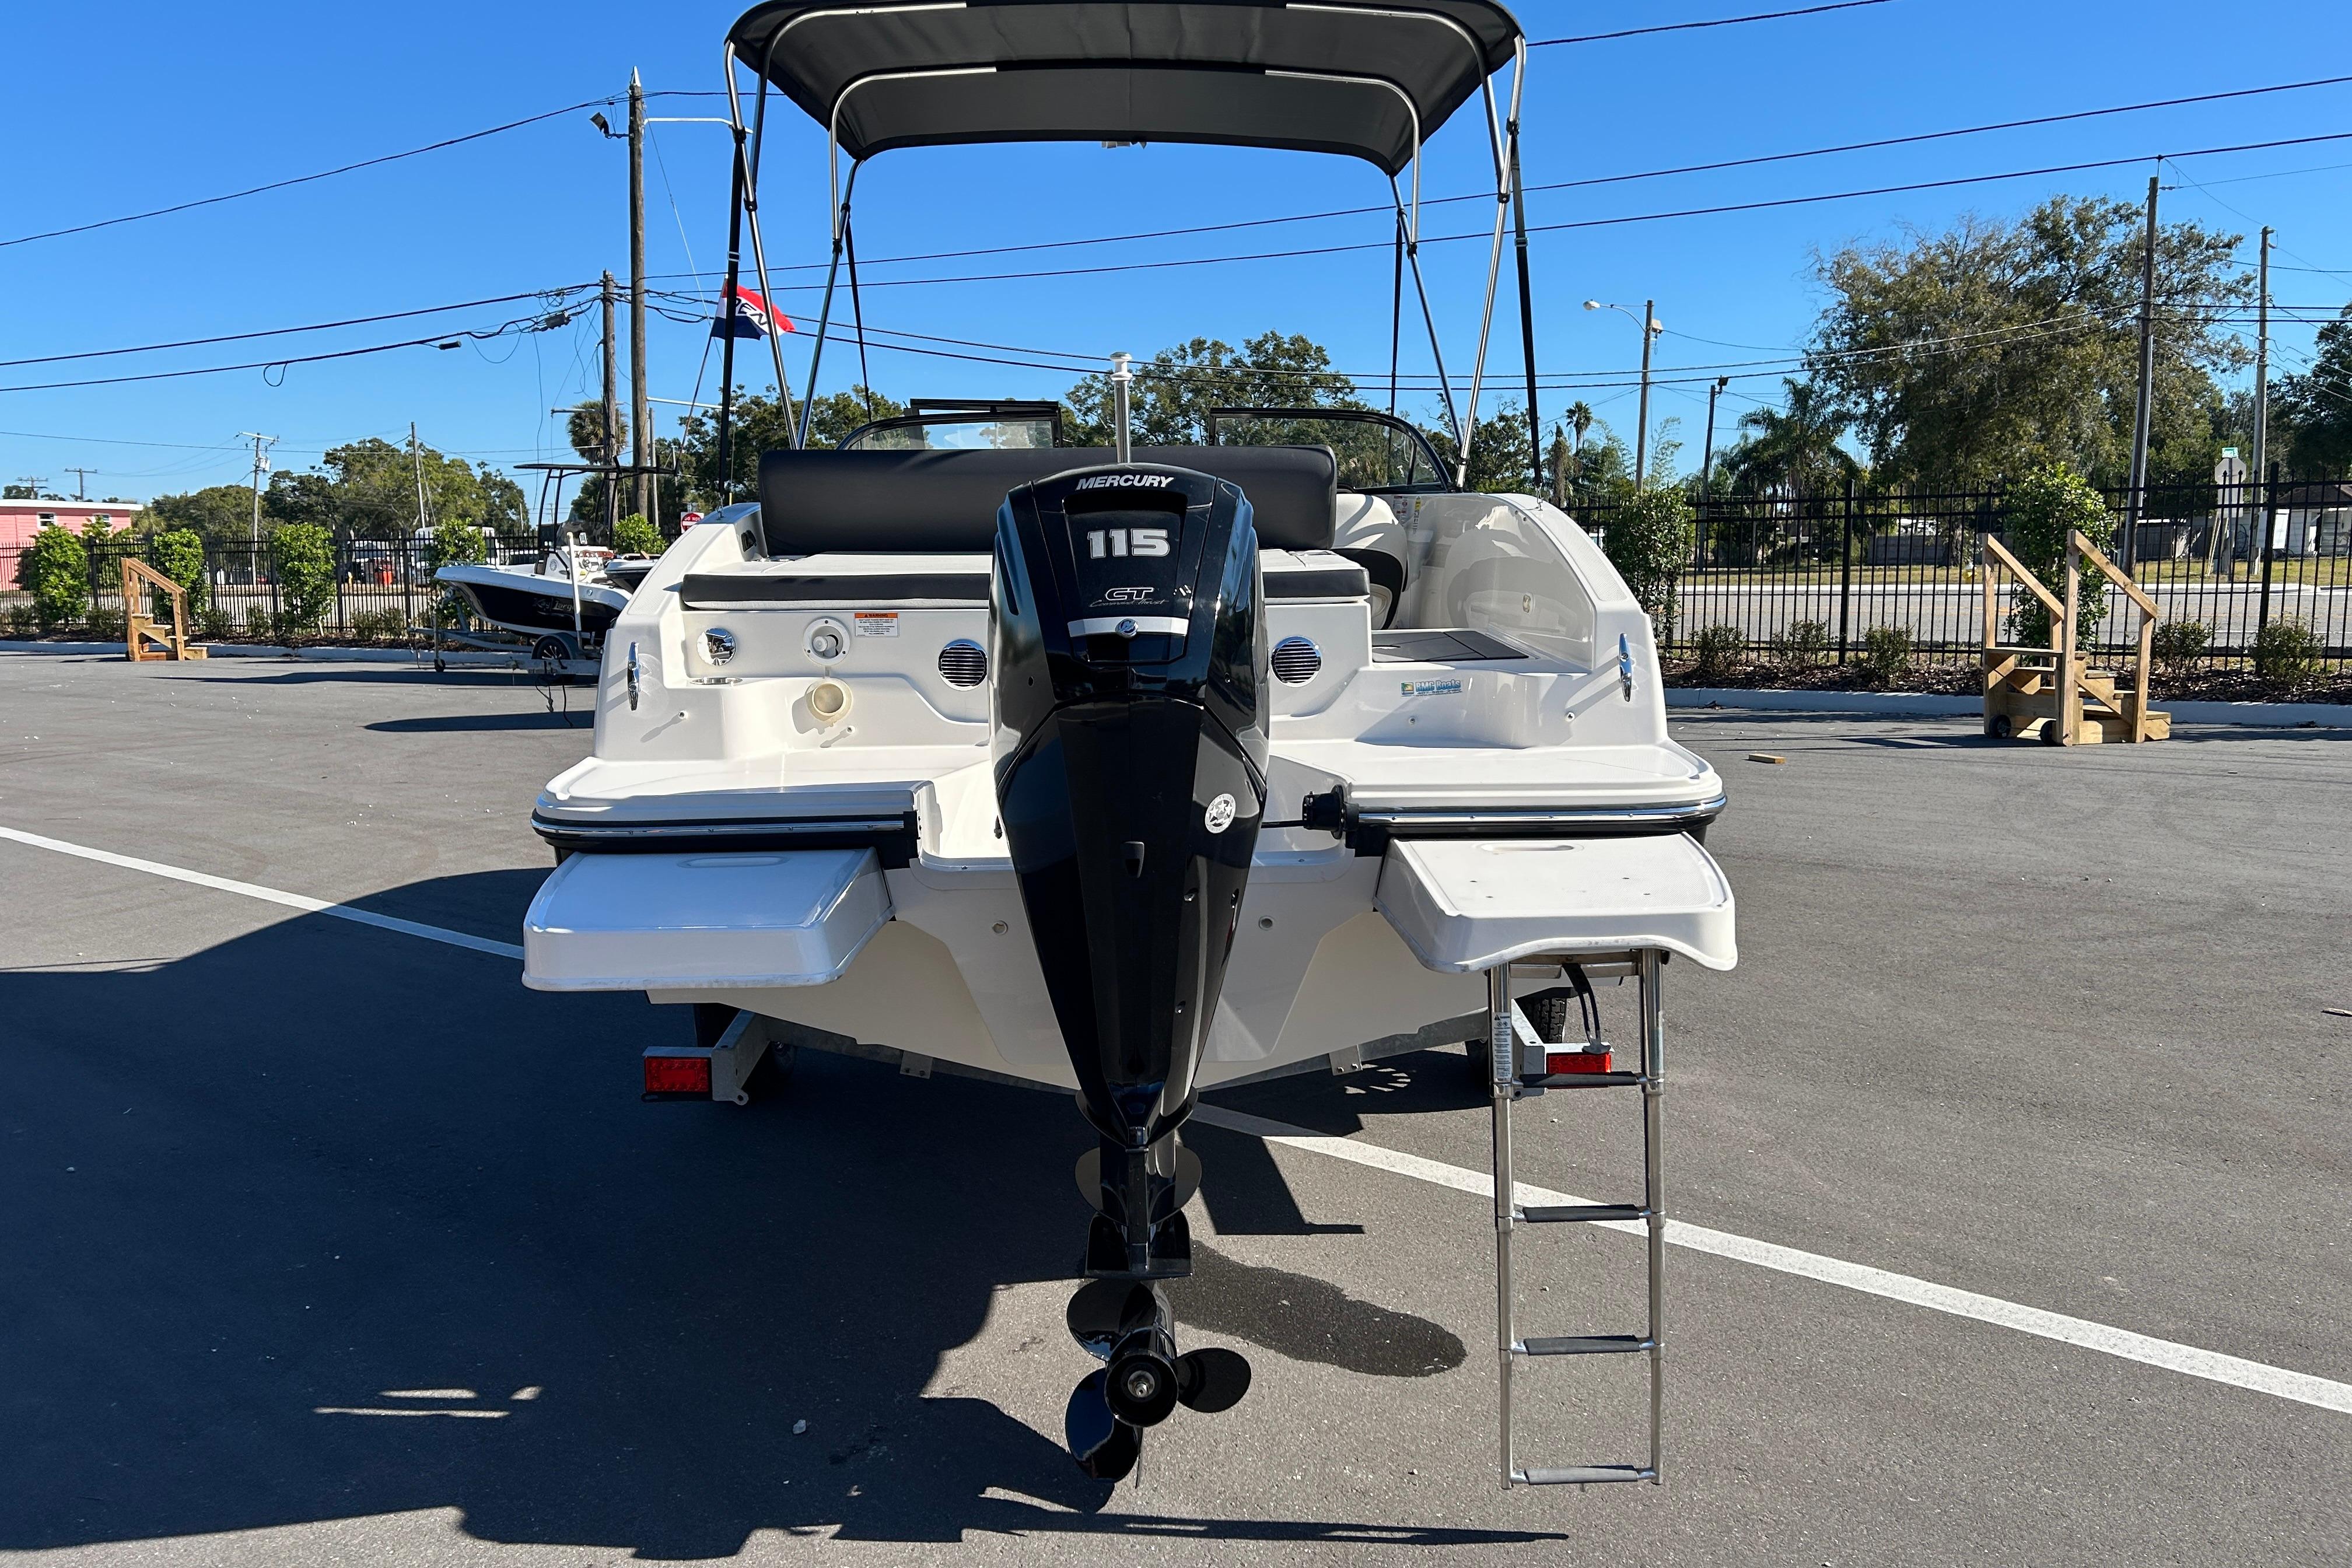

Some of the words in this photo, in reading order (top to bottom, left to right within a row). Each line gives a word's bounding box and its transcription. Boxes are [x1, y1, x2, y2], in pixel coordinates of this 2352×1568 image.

[736, 298, 768, 326] PEN
[1074, 474, 1174, 491] MERCURY
[1087, 528, 1170, 559] 115
[1105, 587, 1154, 601] GT
[552, 600, 574, 612] Larg
[1415, 681, 1435, 692] RMC
[1436, 679, 1461, 691] Boats
